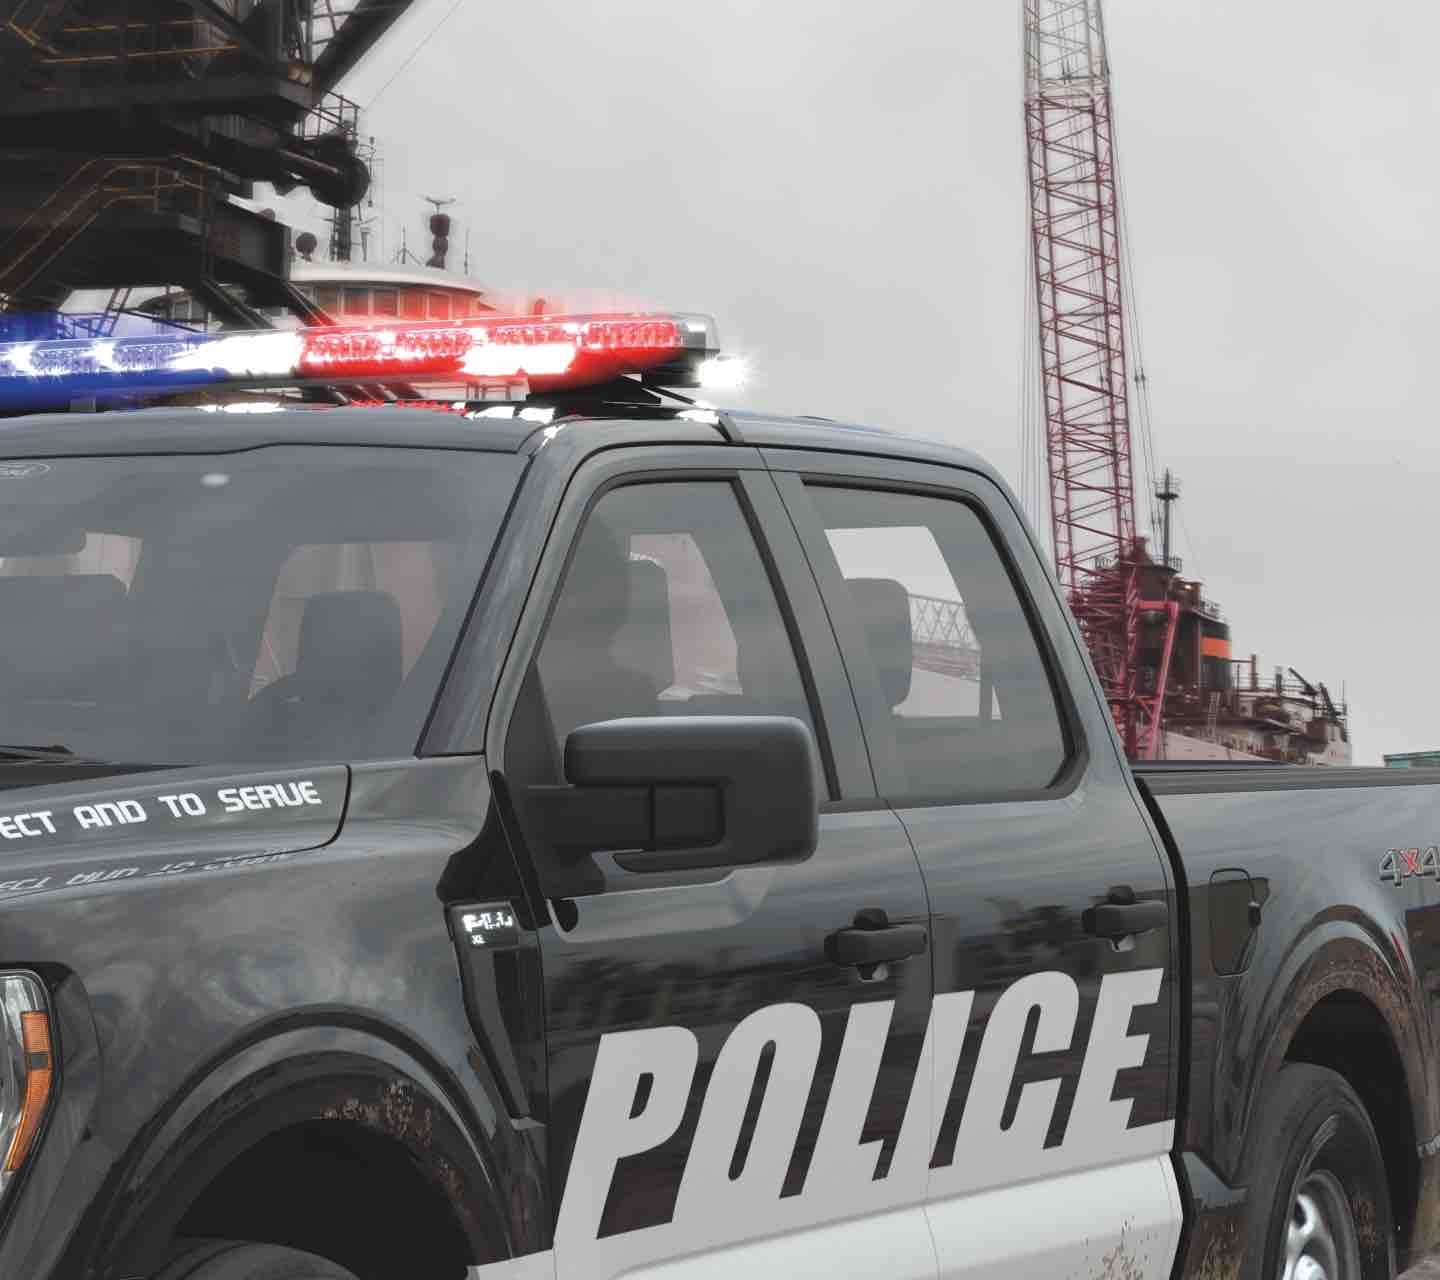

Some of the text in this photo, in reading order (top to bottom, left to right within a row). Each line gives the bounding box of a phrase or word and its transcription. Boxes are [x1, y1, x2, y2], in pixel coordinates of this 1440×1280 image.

[72, 799, 148, 830] AND
[157, 792, 207, 819] TO
[553, 967, 1176, 1240] POLICE
